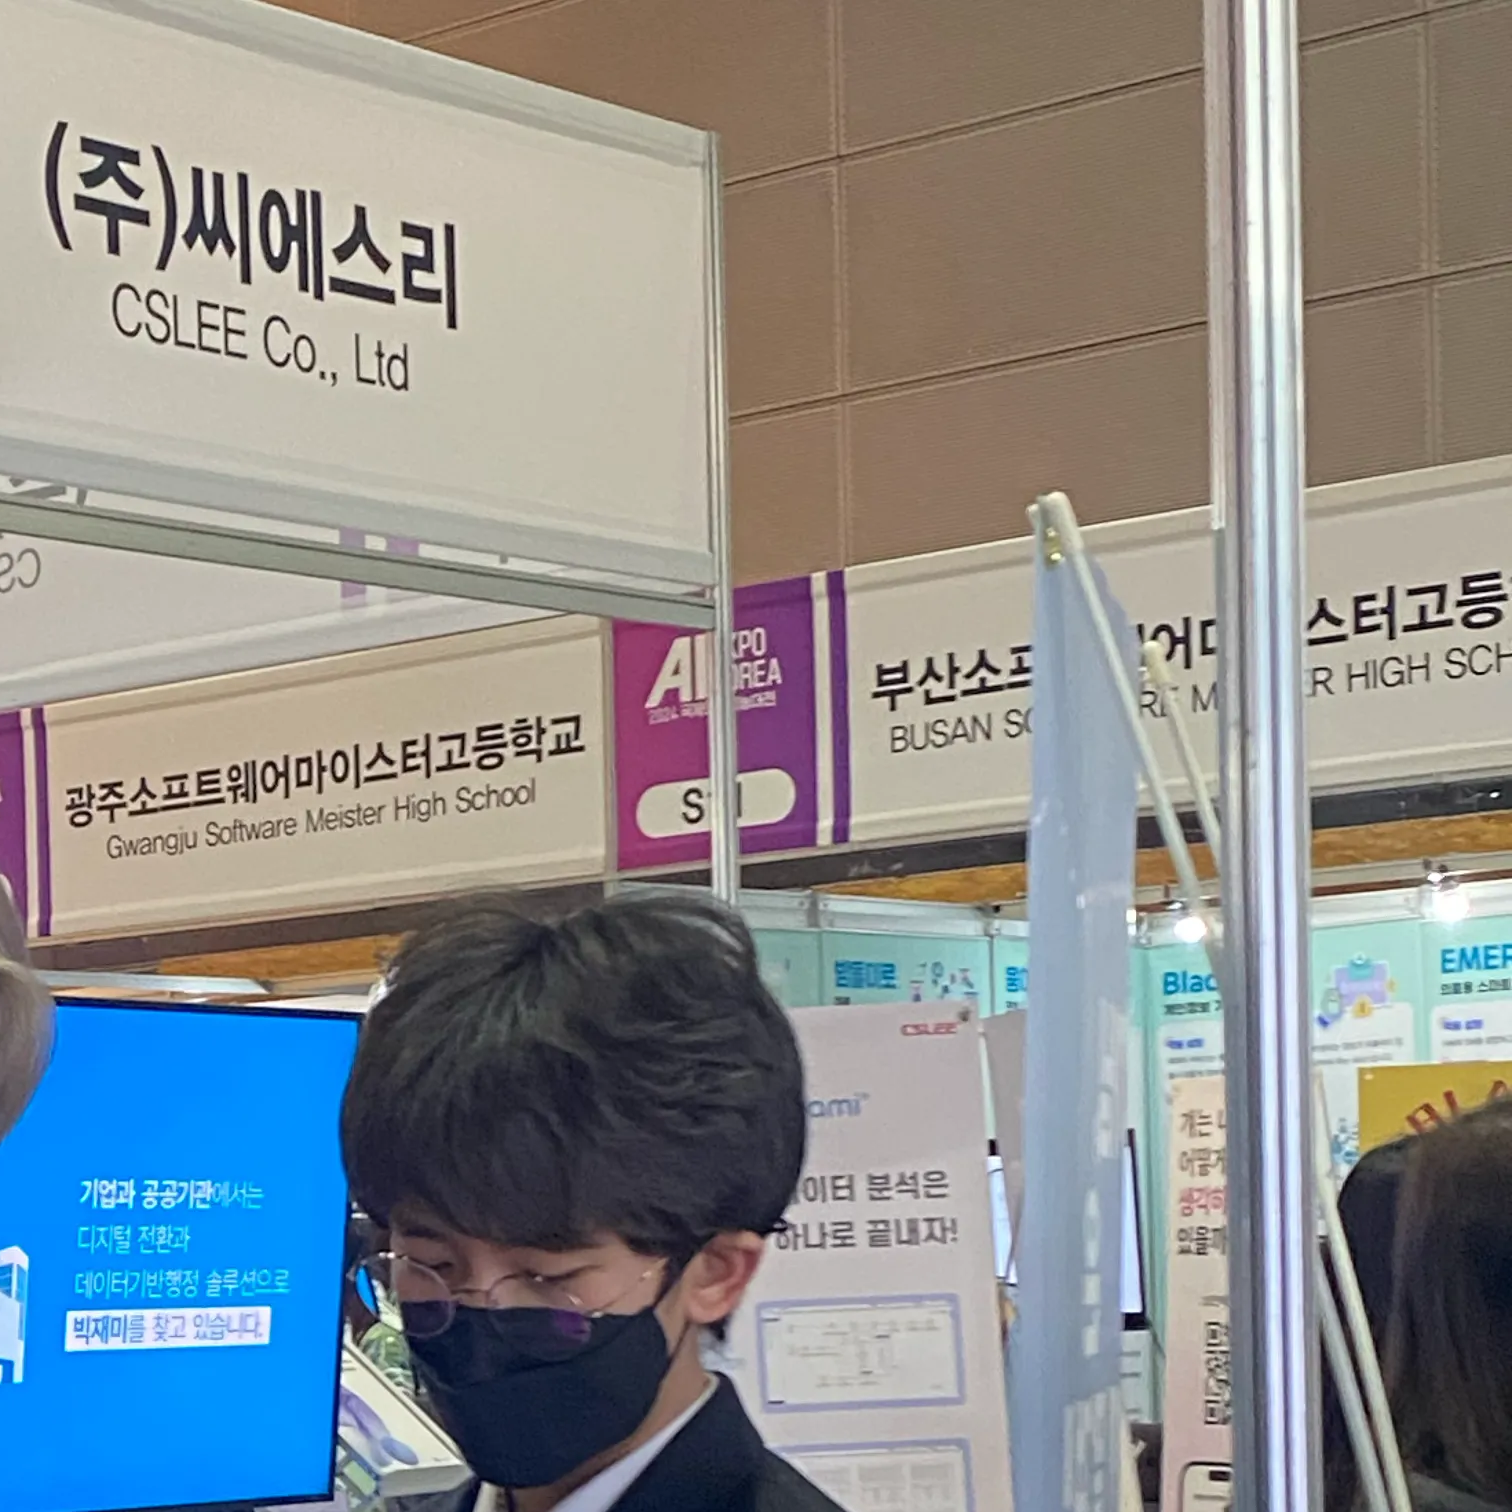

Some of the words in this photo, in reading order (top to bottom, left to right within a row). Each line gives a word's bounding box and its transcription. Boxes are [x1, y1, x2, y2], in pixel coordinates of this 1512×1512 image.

[44, 121, 458, 330] (주)씨에스리
[111, 282, 249, 361] CSLEE
[263, 314, 339, 387] Co.,
[355, 333, 410, 391] Ltd
[890, 711, 993, 753] BUSAN
[1347, 651, 1432, 693] HIGH
[65, 714, 586, 828] 광주소프트웨어마이스터고등학교
[106, 826, 199, 860] Gwangju
[205, 815, 298, 847] Software
[305, 800, 387, 833] Meister
[393, 790, 447, 824] High
[455, 777, 537, 814] School
[79, 1178, 136, 1210] 기업과
[141, 1178, 265, 1210] 공공기관에서는
[796, 1174, 855, 1202] 이터
[866, 1169, 950, 1201] 분석은
[77, 1224, 132, 1255] 디지털
[137, 1224, 191, 1255] 전환과
[866, 1216, 959, 1249] 끝내자!
[74, 1268, 200, 1300] 데이터기반행정
[204, 1267, 291, 1297] 솔루션으로
[73, 1313, 146, 1346] 빅재미를
[152, 1312, 187, 1342] 찾고
[192, 1309, 264, 1341] 있습니다.
